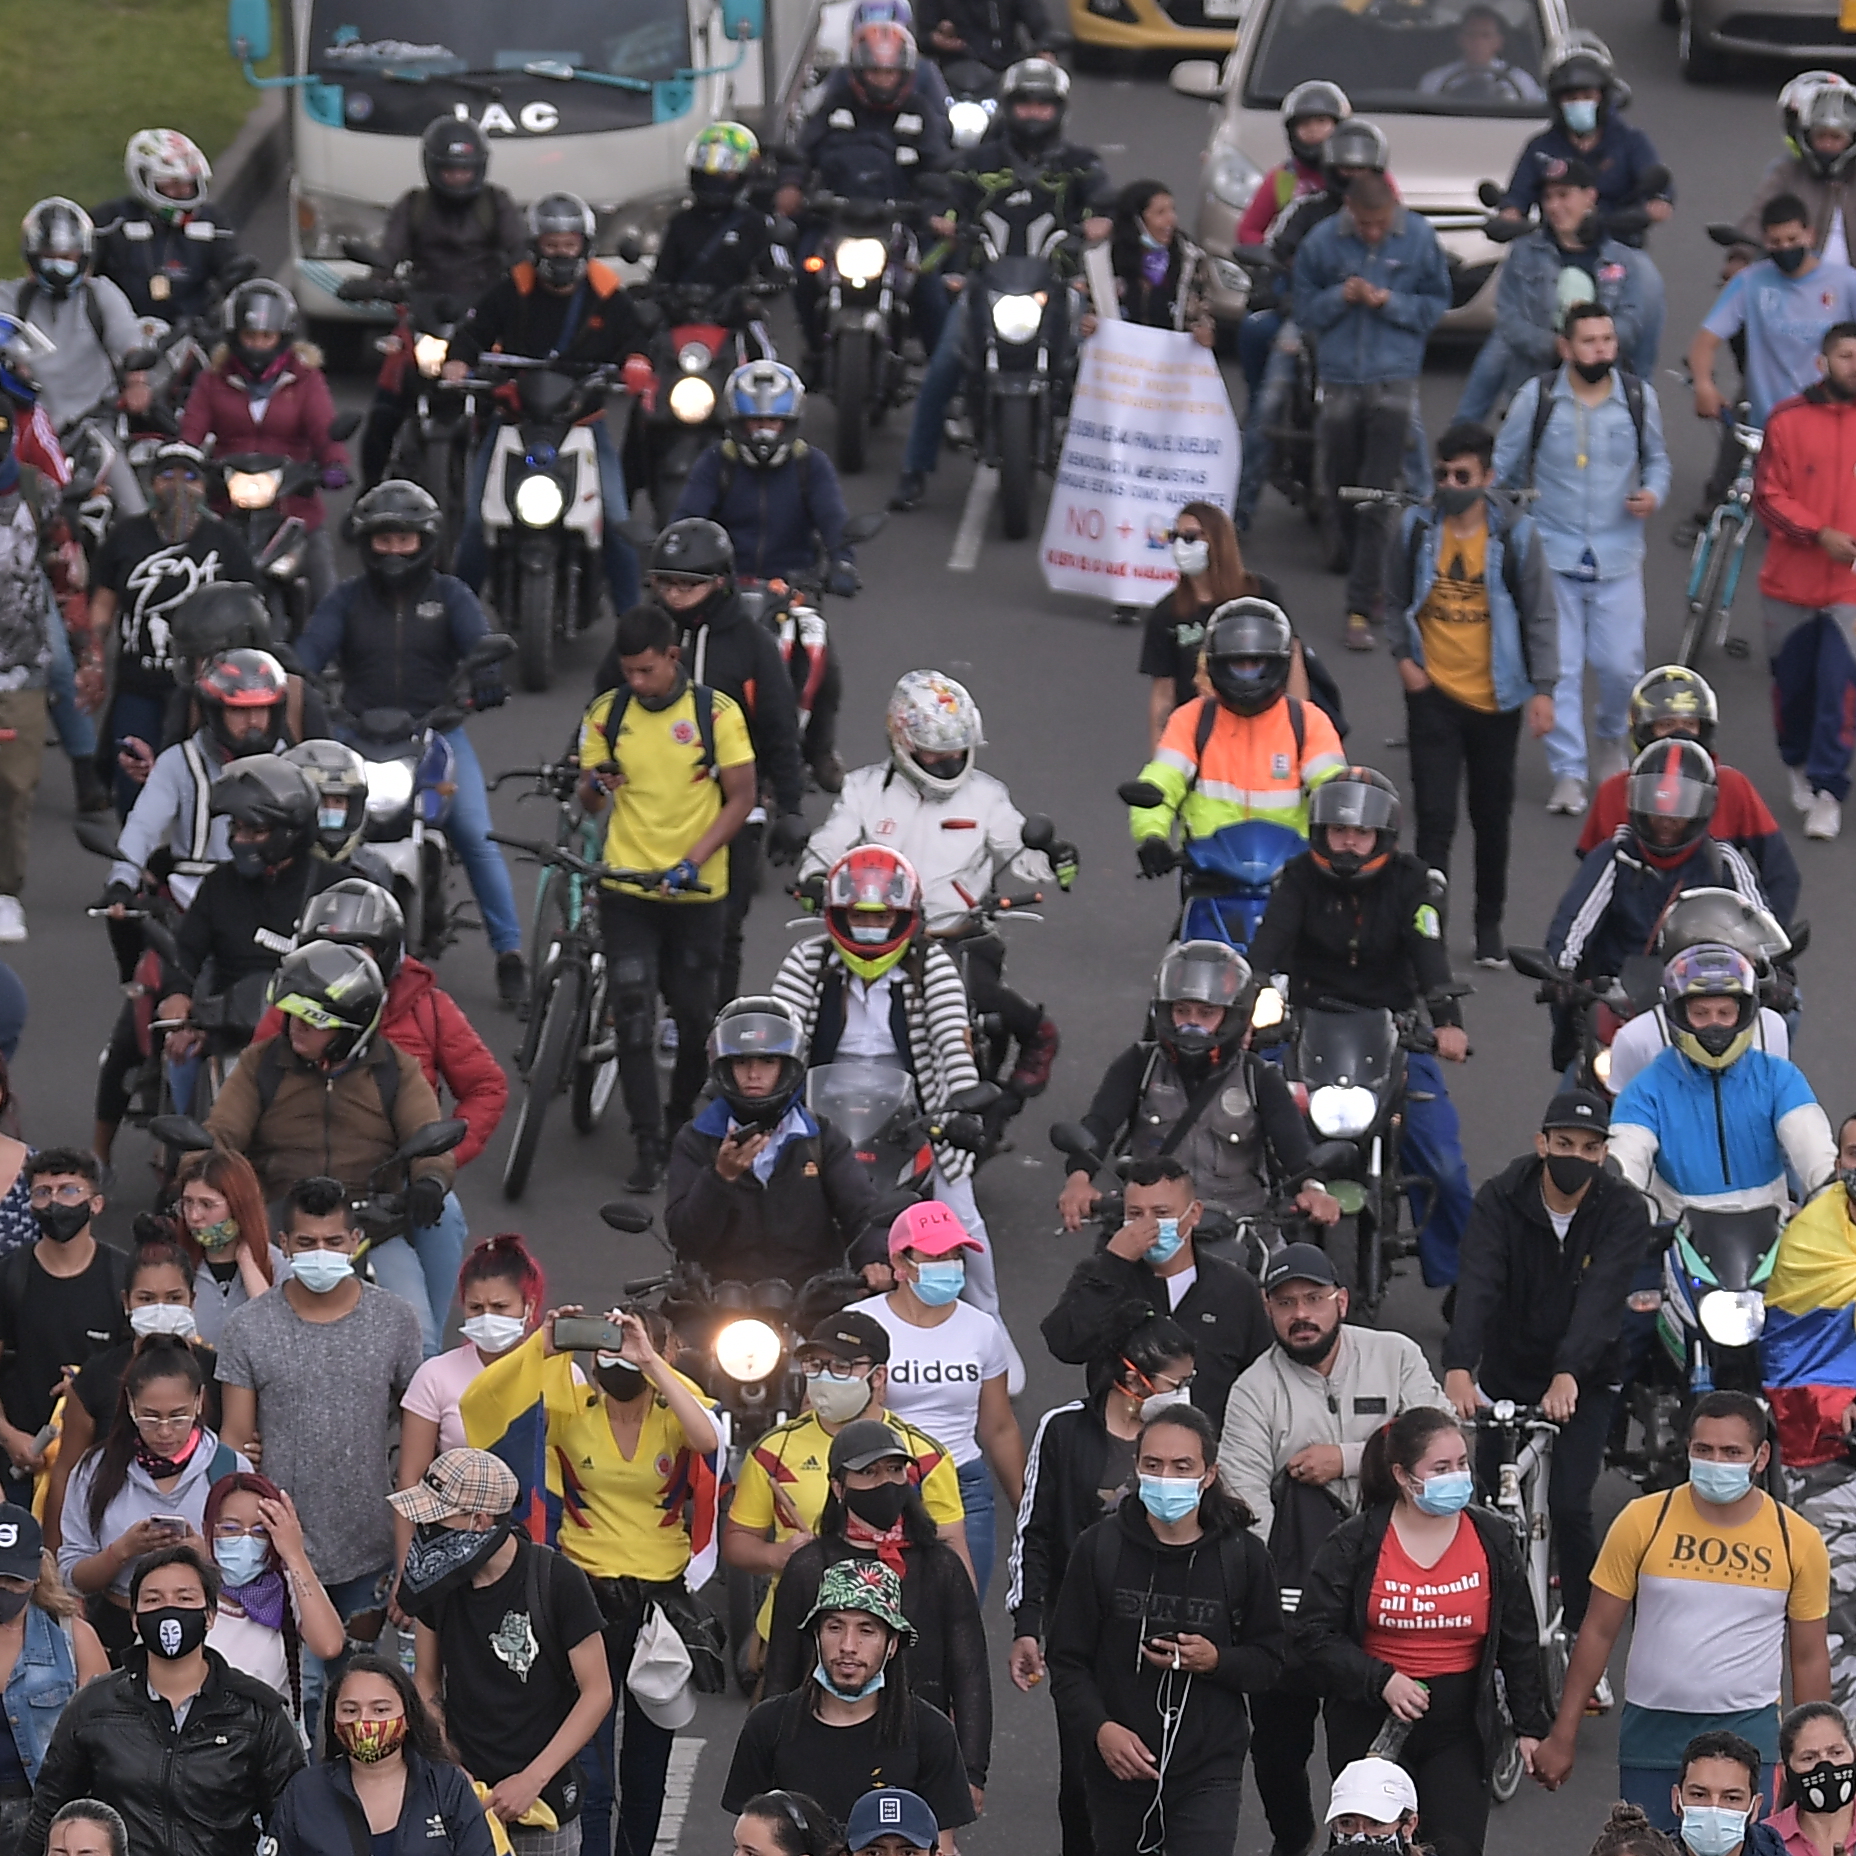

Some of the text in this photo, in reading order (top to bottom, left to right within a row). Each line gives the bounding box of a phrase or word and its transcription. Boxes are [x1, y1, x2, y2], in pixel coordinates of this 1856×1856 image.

[1065, 505, 1107, 542] NO
[1674, 1533, 1774, 1575] BOSS
[1385, 1572, 1480, 1596] we should
[1380, 1597, 1436, 1613] all be
[1378, 1613, 1473, 1629] feminists
